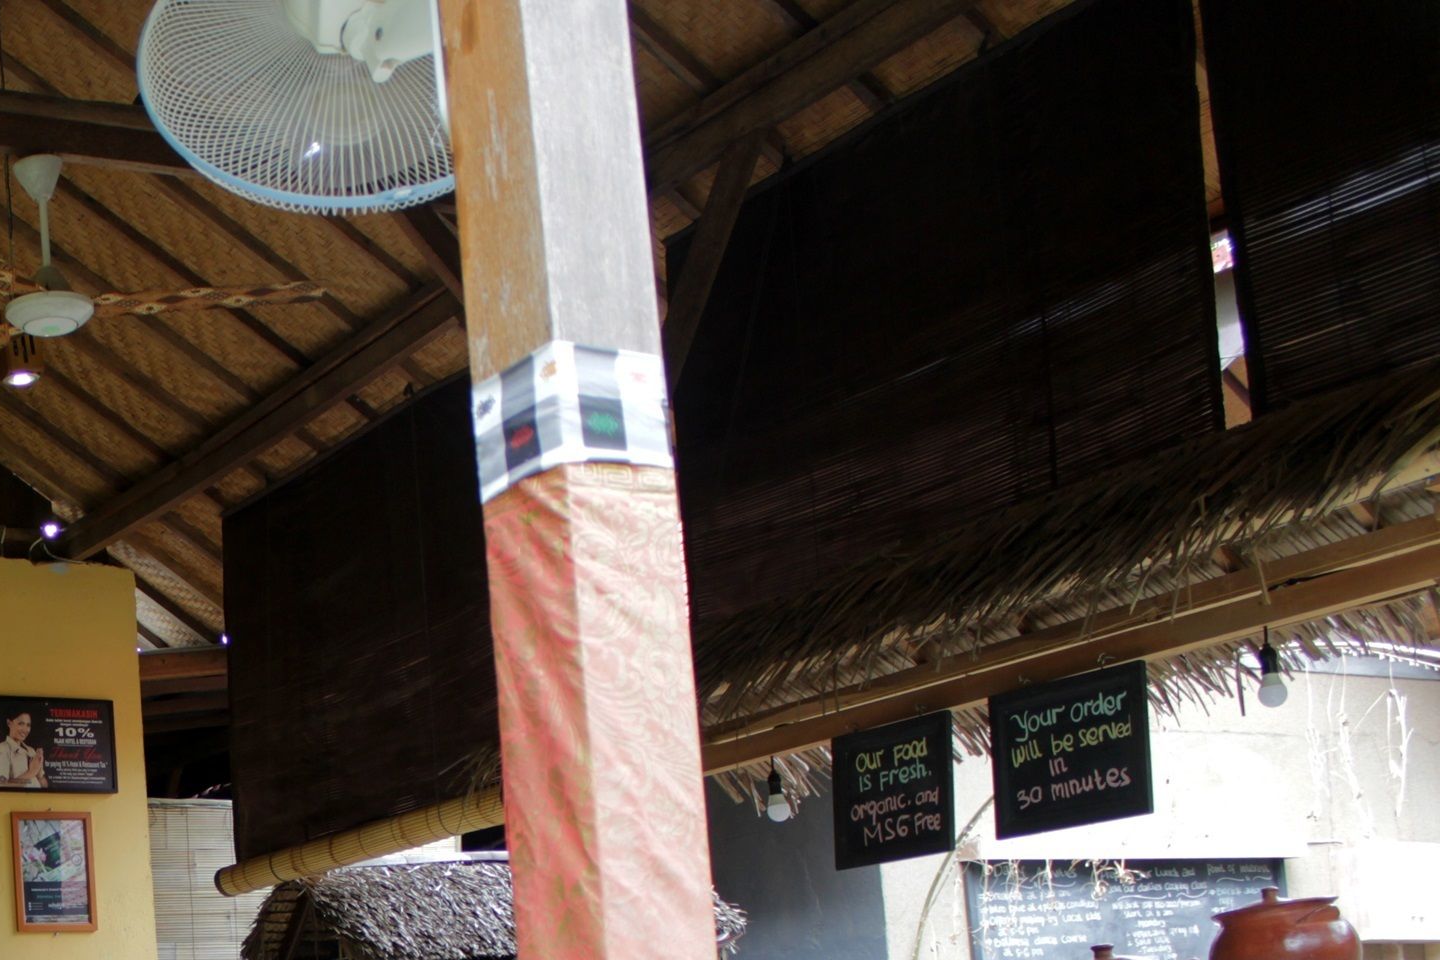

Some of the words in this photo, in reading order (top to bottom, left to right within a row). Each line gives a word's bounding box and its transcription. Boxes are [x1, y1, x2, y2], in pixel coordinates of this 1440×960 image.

[55, 727, 95, 738] 10%
[1010, 705, 1065, 742] Your
[1070, 690, 1127, 722] order
[893, 737, 928, 766] Food
[1011, 739, 1043, 768] will
[1051, 733, 1074, 755] be
[1078, 714, 1132, 747] served
[915, 786, 939, 805] and
[1017, 786, 1042, 810] 30
[1051, 767, 1131, 801] minutes
[864, 815, 910, 847] MSG
[914, 812, 941, 836] Free
